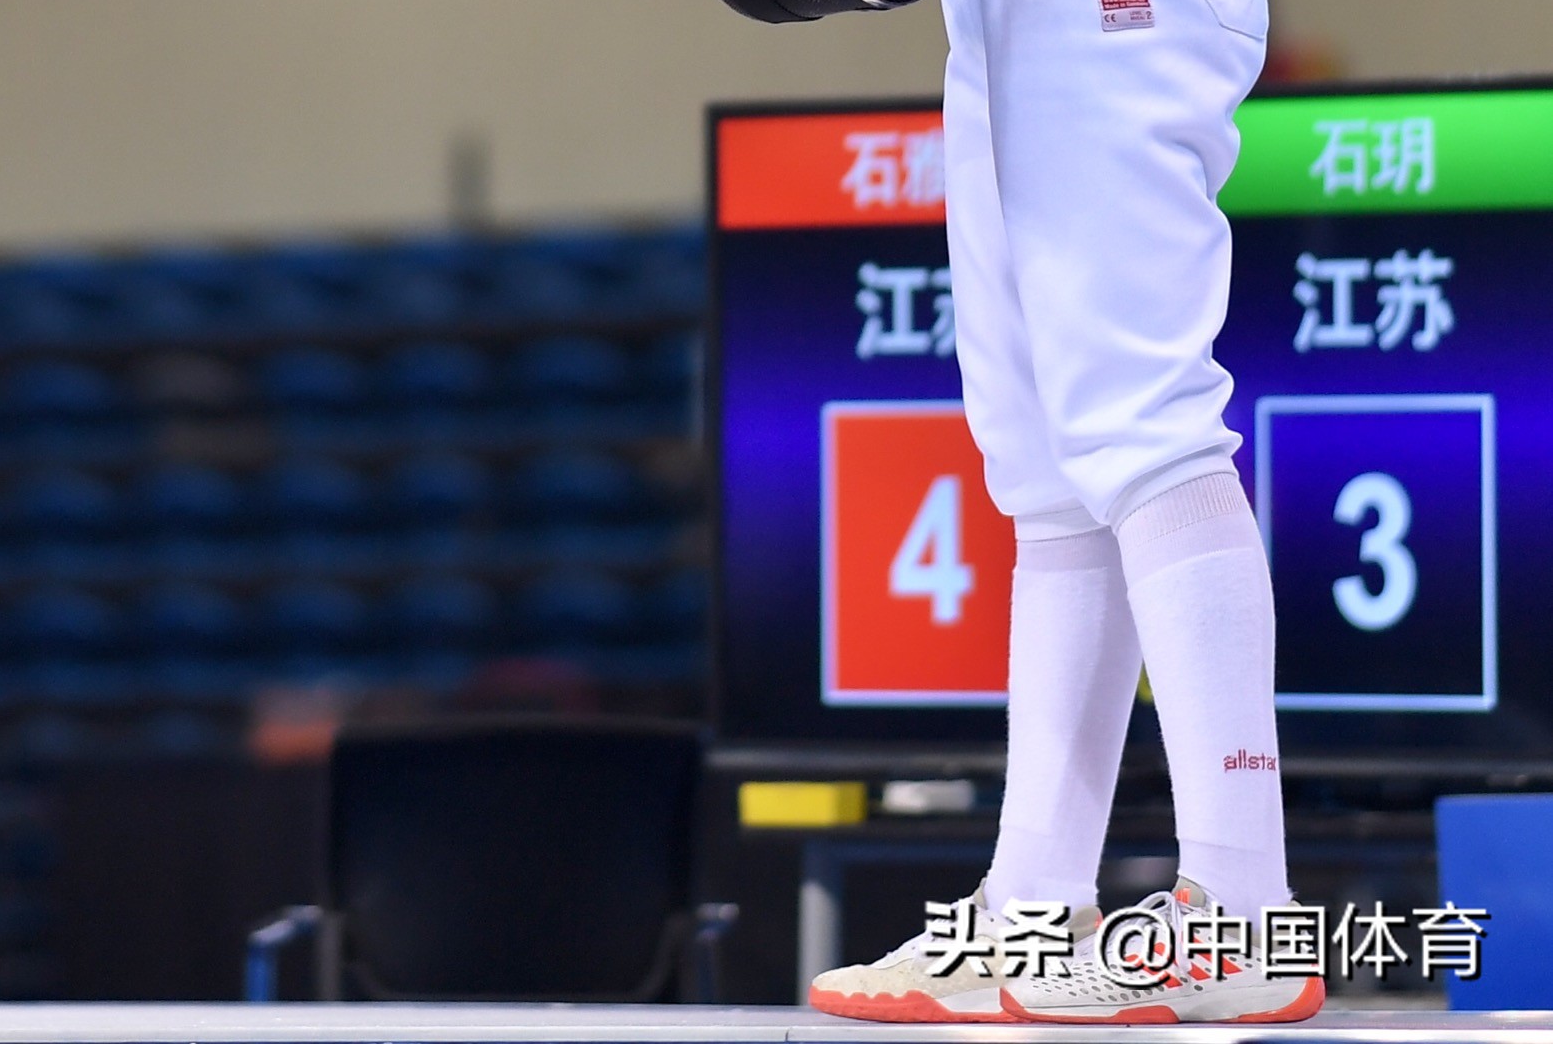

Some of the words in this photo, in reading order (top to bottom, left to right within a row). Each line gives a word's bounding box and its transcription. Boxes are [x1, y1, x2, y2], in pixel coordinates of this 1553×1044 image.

[1309, 116, 1436, 197] 石玥
[1292, 249, 1456, 354] 江苏
[888, 474, 974, 626] 4
[1331, 471, 1418, 632] 3
[1223, 749, 1276, 772] allsta
